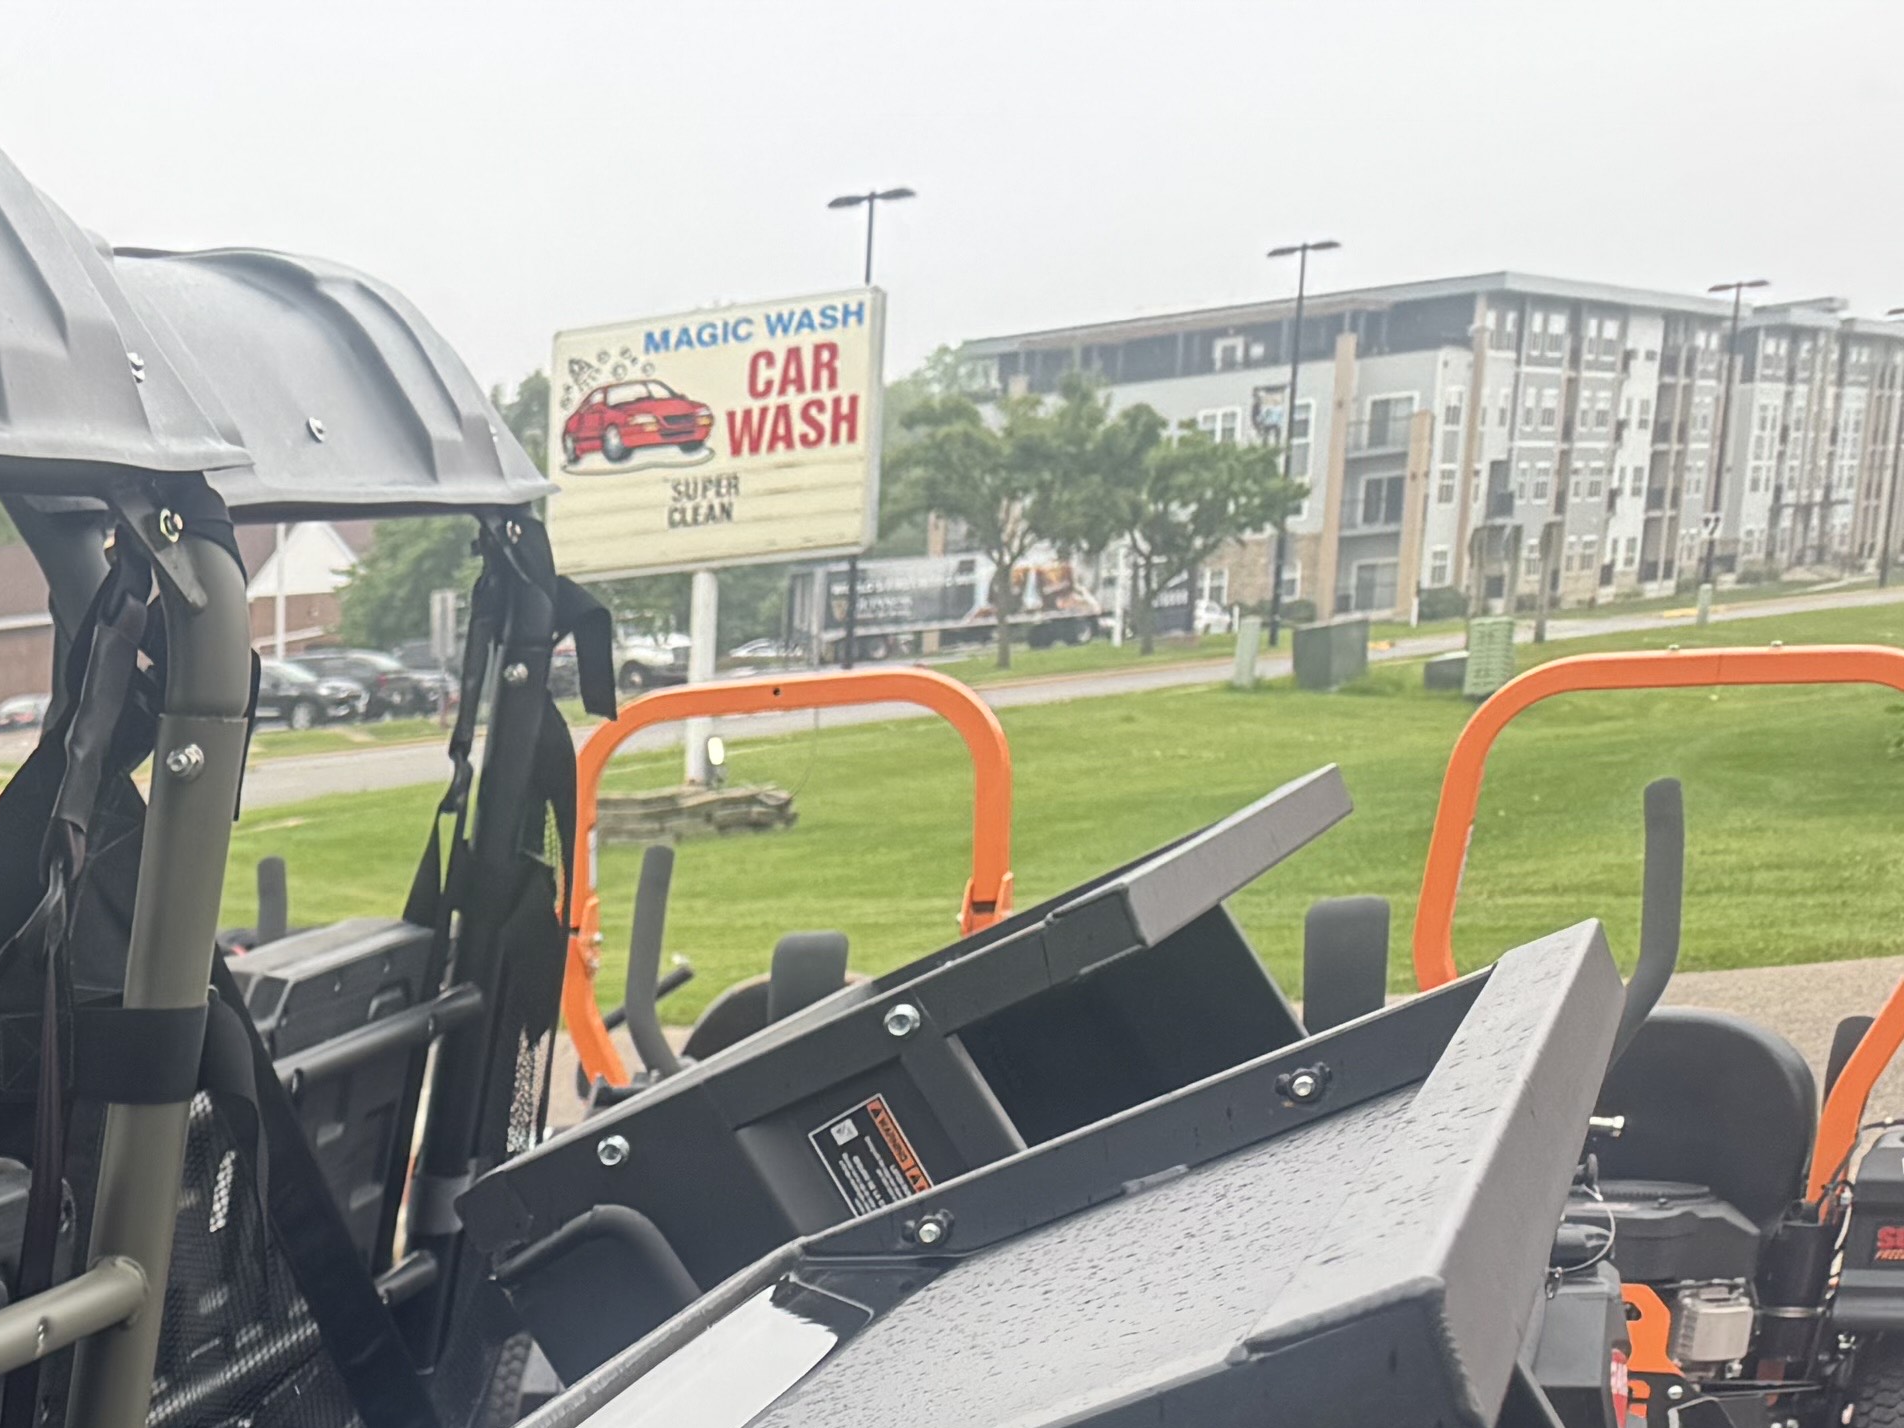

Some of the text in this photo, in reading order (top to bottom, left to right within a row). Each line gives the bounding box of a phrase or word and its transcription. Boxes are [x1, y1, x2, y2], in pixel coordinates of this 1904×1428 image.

[643, 301, 865, 355] MAGIC WASH
[747, 342, 839, 400] CAR
[725, 394, 860, 457] WASH
[671, 471, 740, 502] SUPER
[667, 502, 734, 529] CLEAN
